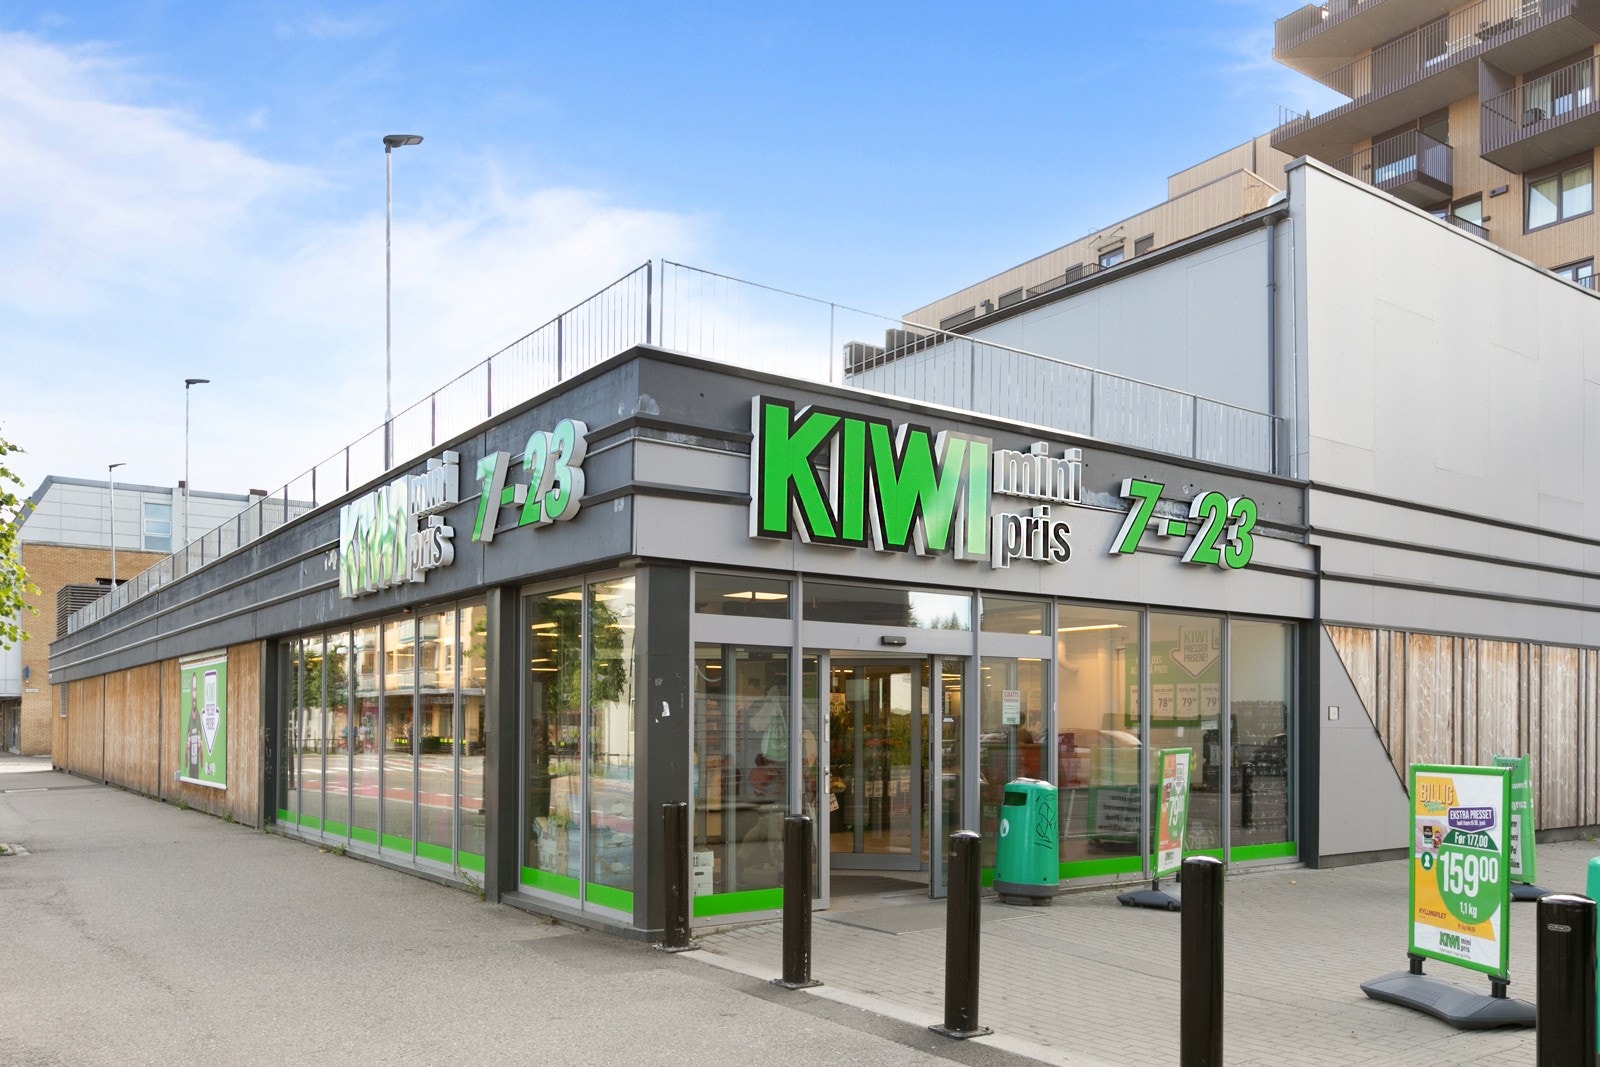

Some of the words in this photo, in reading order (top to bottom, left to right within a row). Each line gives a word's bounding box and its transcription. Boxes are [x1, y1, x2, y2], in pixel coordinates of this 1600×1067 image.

[471, 418, 587, 543] 7-23
[752, 395, 992, 562] KIWI
[993, 441, 1082, 504] mini
[1109, 478, 1258, 569] 7-23
[992, 504, 1072, 569] pris
[411, 515, 455, 583] pris
[1183, 629, 1208, 643] KIWI
[1004, 690, 1019, 699] GRATIS
[1420, 783, 1454, 806] BILLIG
[1450, 810, 1469, 820] EKSTRA
[1470, 809, 1492, 820] PRESSET
[1454, 832, 1466, 845] Før
[1467, 833, 1488, 848] 177,00
[1418, 908, 1446, 920] KYLLINGFILET
[1460, 902, 1468, 915] 1,1
[1468, 903, 1478, 918] kg
[1440, 931, 1460, 950] KIWI
